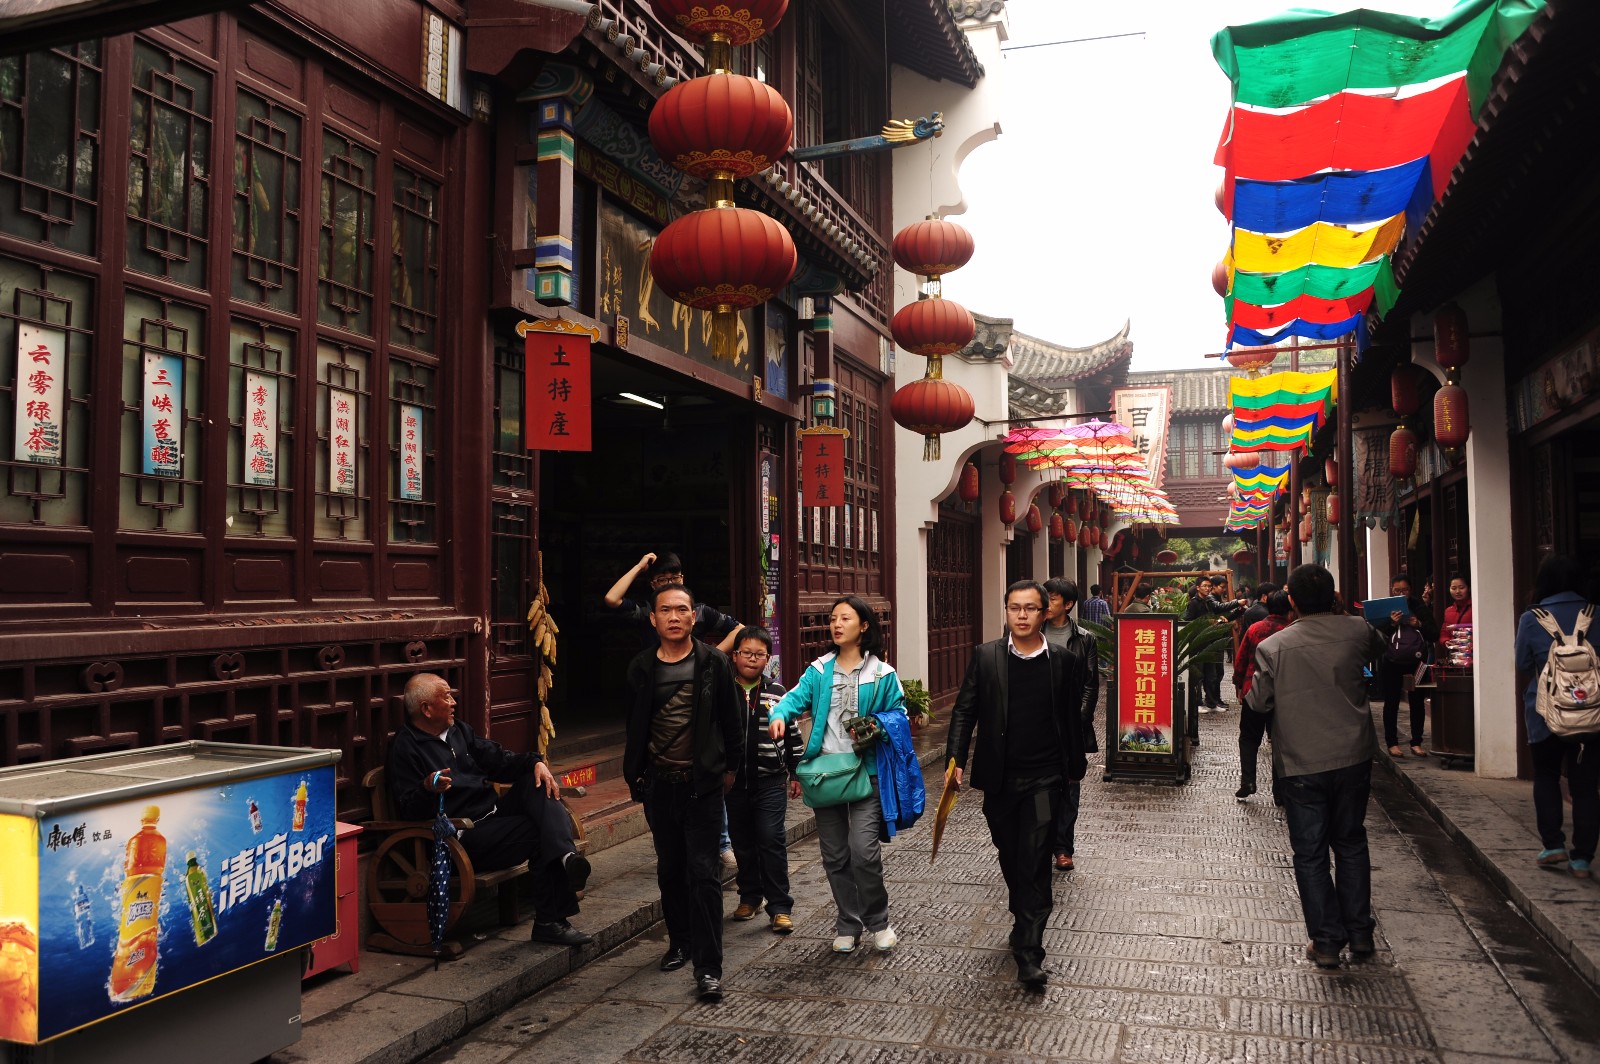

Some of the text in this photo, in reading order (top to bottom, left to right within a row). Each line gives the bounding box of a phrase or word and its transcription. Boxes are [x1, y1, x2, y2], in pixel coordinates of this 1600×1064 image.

[23, 344, 54, 453] 云雾绿茶
[151, 369, 174, 464] 三峡苕酥
[250, 385, 268, 473] 孝感麻糖
[335, 400, 350, 485] 洪湖红莲子
[1134, 628, 1156, 724] 特产平价超市
[92, 829, 112, 842] 饮品
